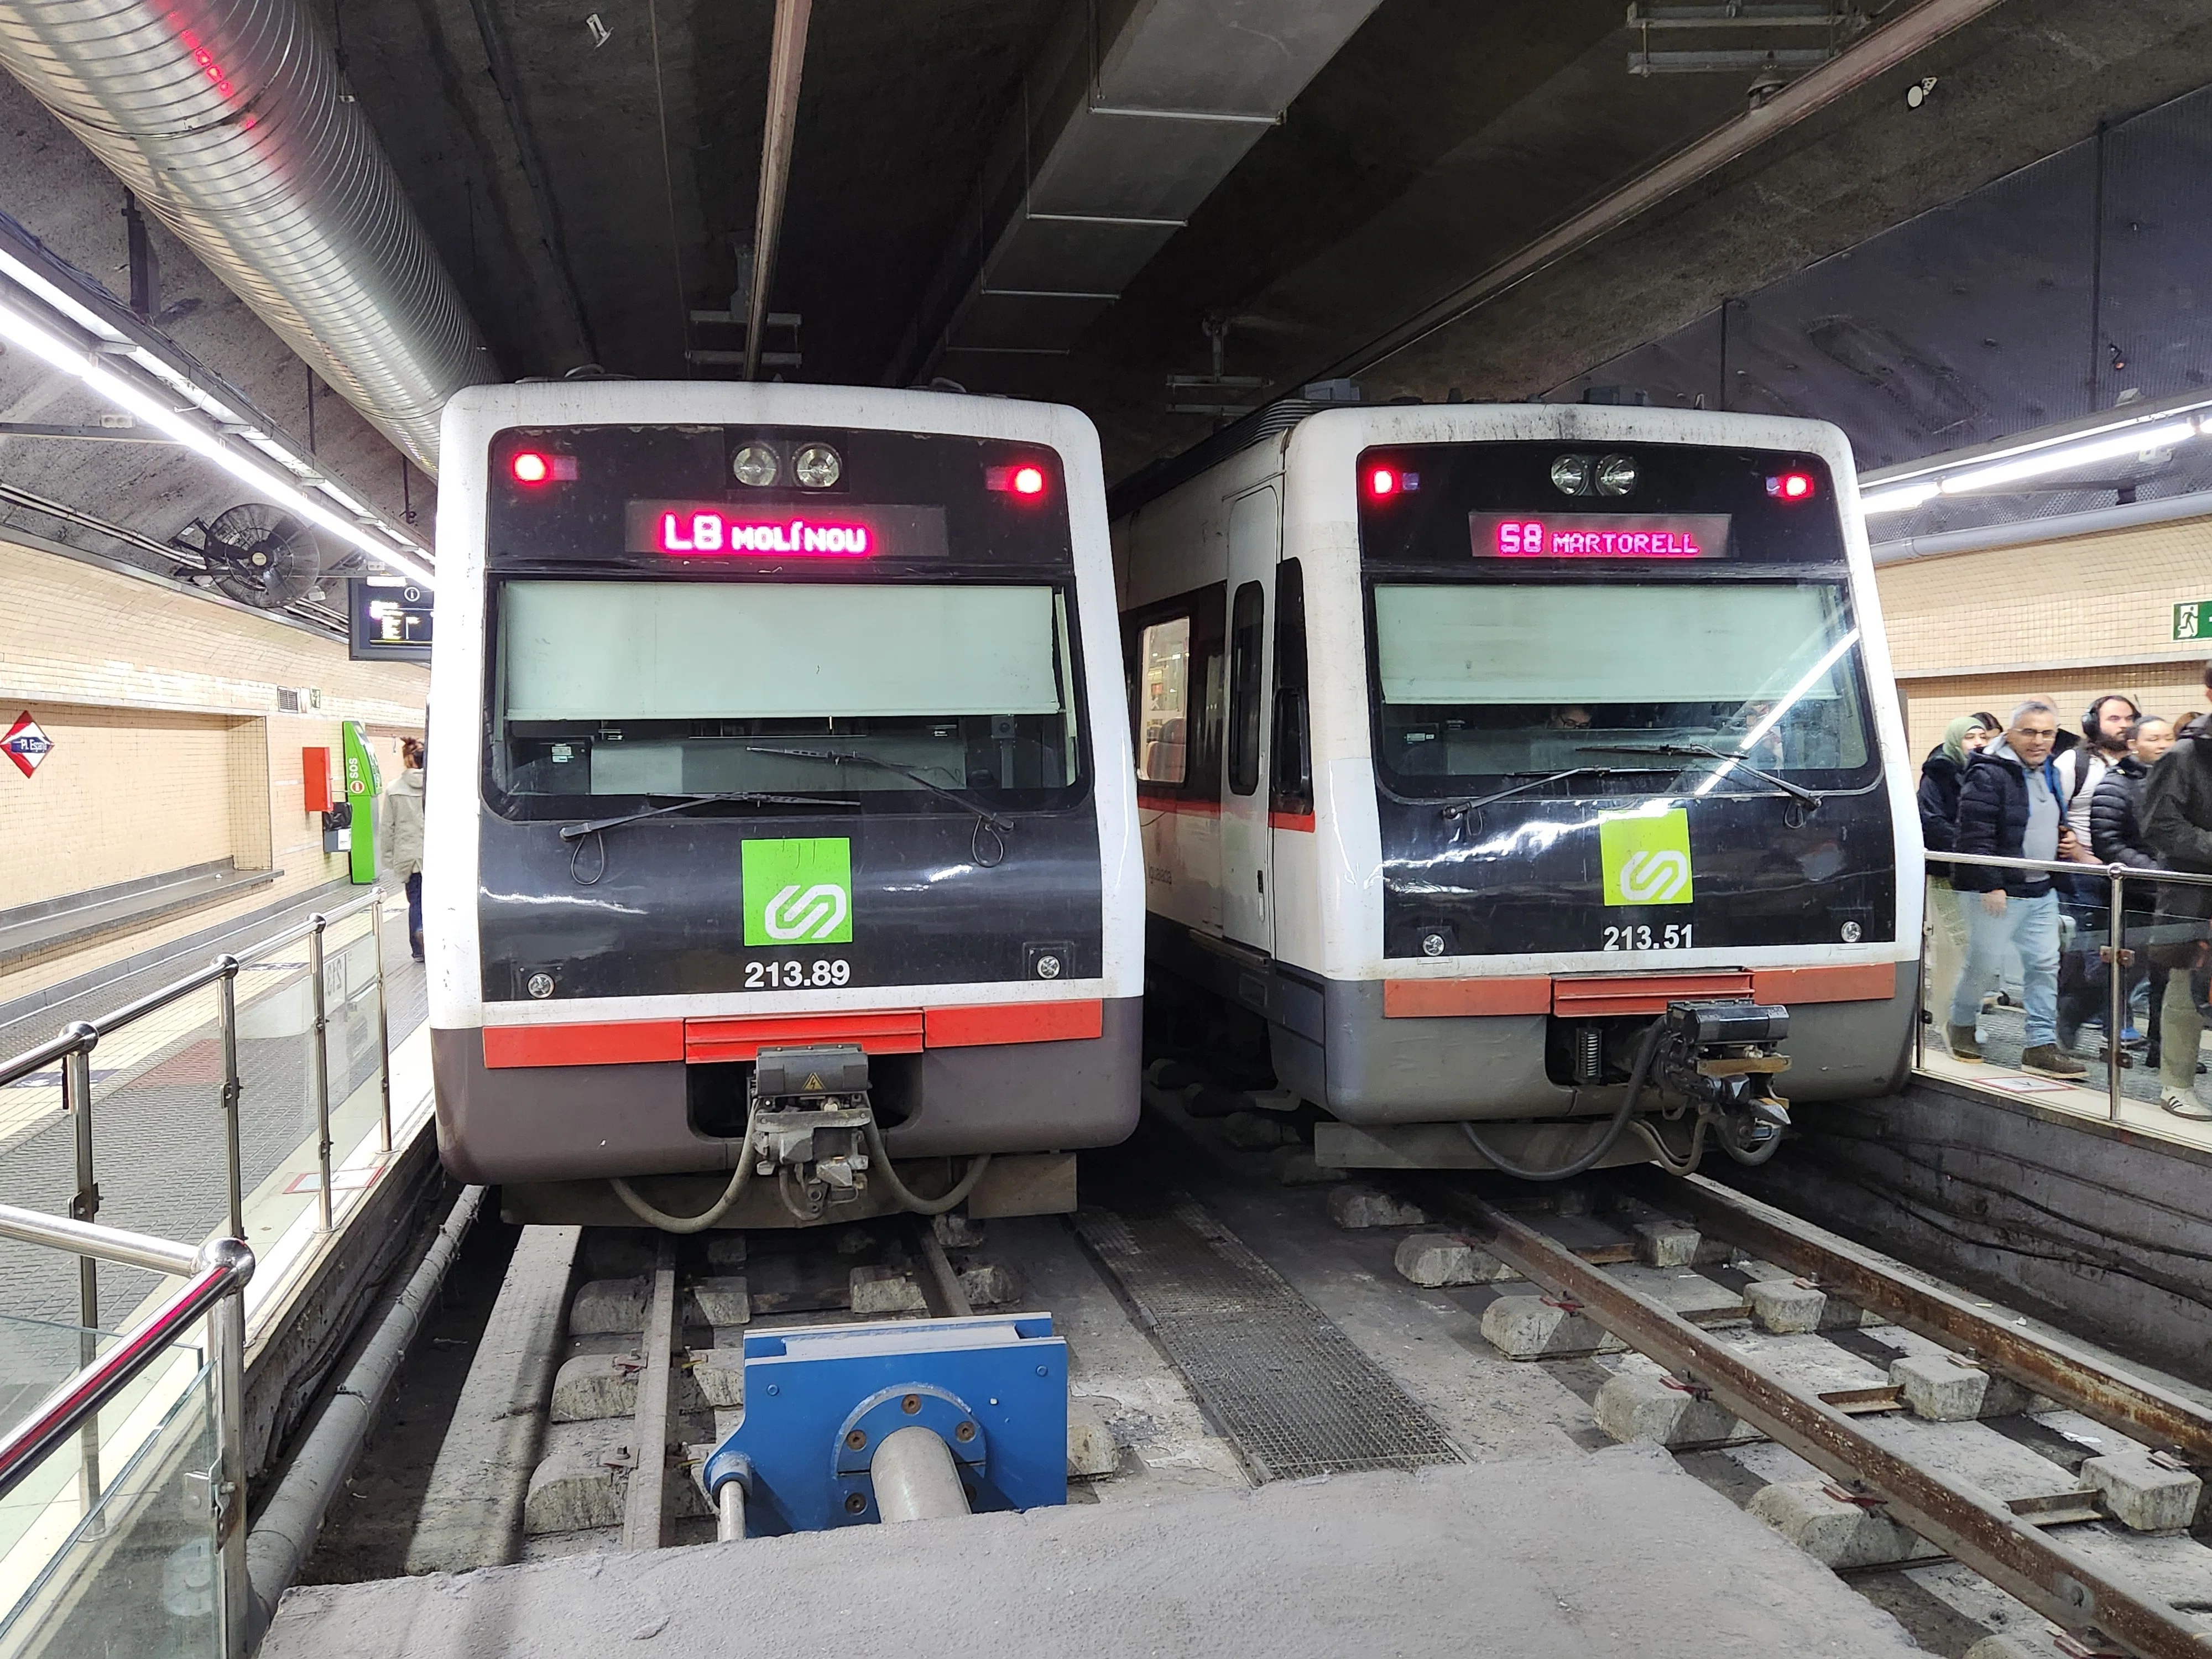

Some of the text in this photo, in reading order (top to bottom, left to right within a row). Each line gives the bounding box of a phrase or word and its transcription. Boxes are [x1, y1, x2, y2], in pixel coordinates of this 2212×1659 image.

[1501, 523, 1700, 554] S8 MARTORELL
[348, 758, 359, 779] SOS
[1604, 924, 1692, 951] 213.51
[744, 959, 851, 988] 213.89
